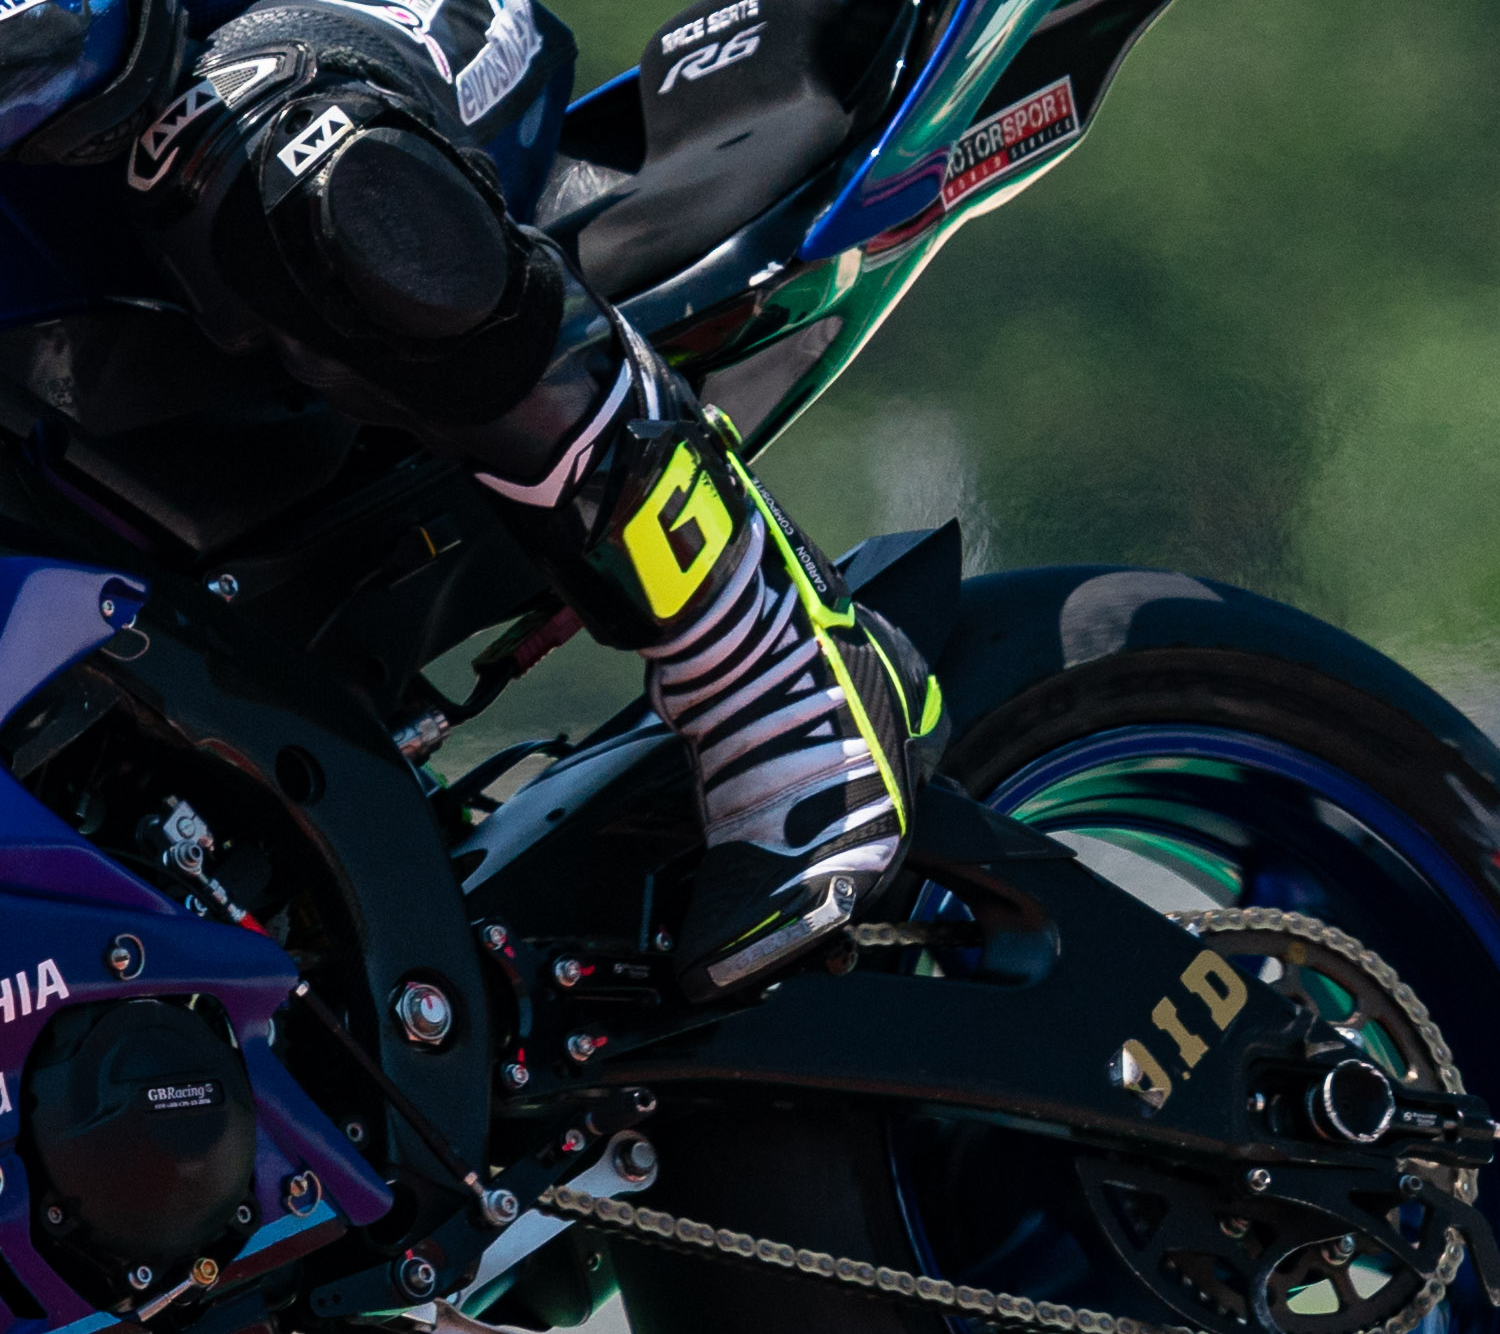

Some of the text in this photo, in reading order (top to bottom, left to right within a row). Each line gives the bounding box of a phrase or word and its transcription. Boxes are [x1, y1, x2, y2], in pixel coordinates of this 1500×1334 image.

[658, 22, 767, 95] R6
[663, 13, 704, 55] RACE
[796, 545, 828, 594] CARBON
